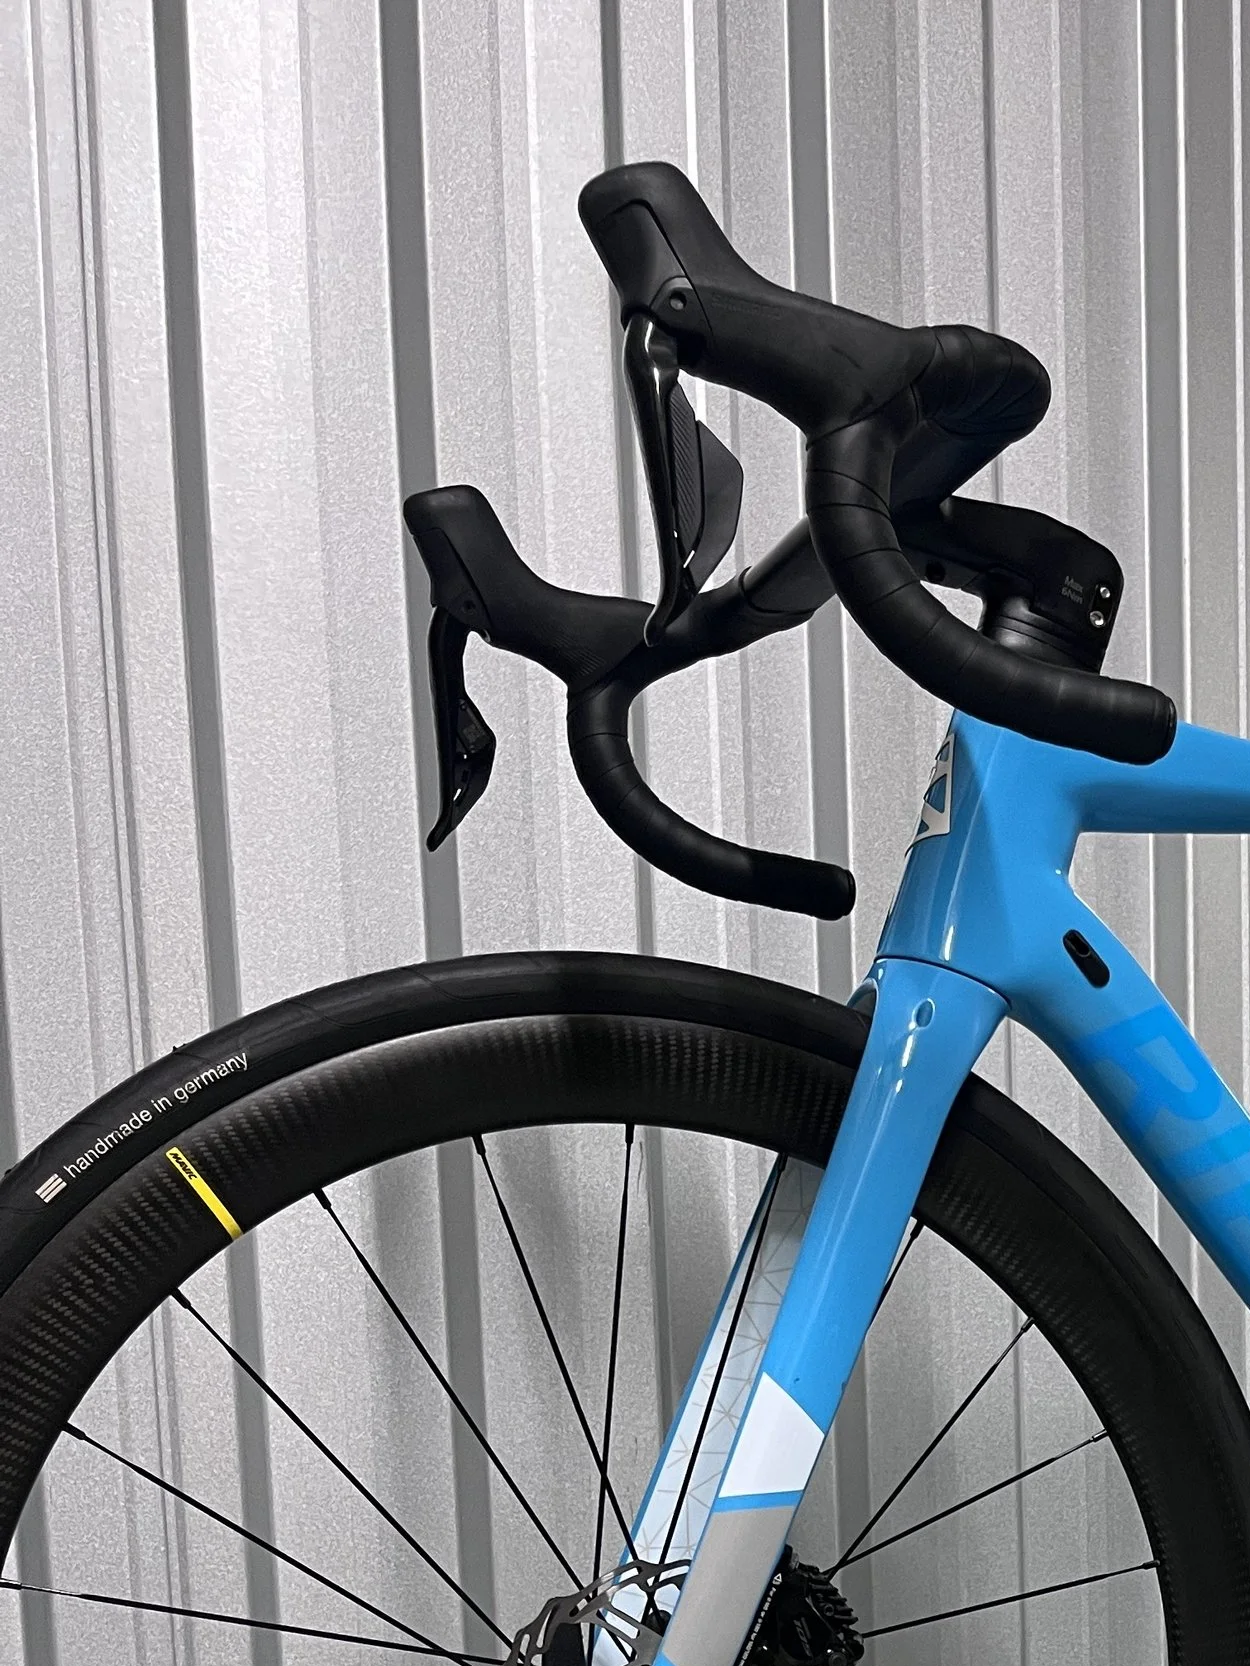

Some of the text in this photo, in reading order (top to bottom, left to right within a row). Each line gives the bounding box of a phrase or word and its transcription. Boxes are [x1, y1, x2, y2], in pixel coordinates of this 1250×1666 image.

[64, 1051, 248, 1179] handmade in germany
[169, 1151, 197, 1181] MAVIC
